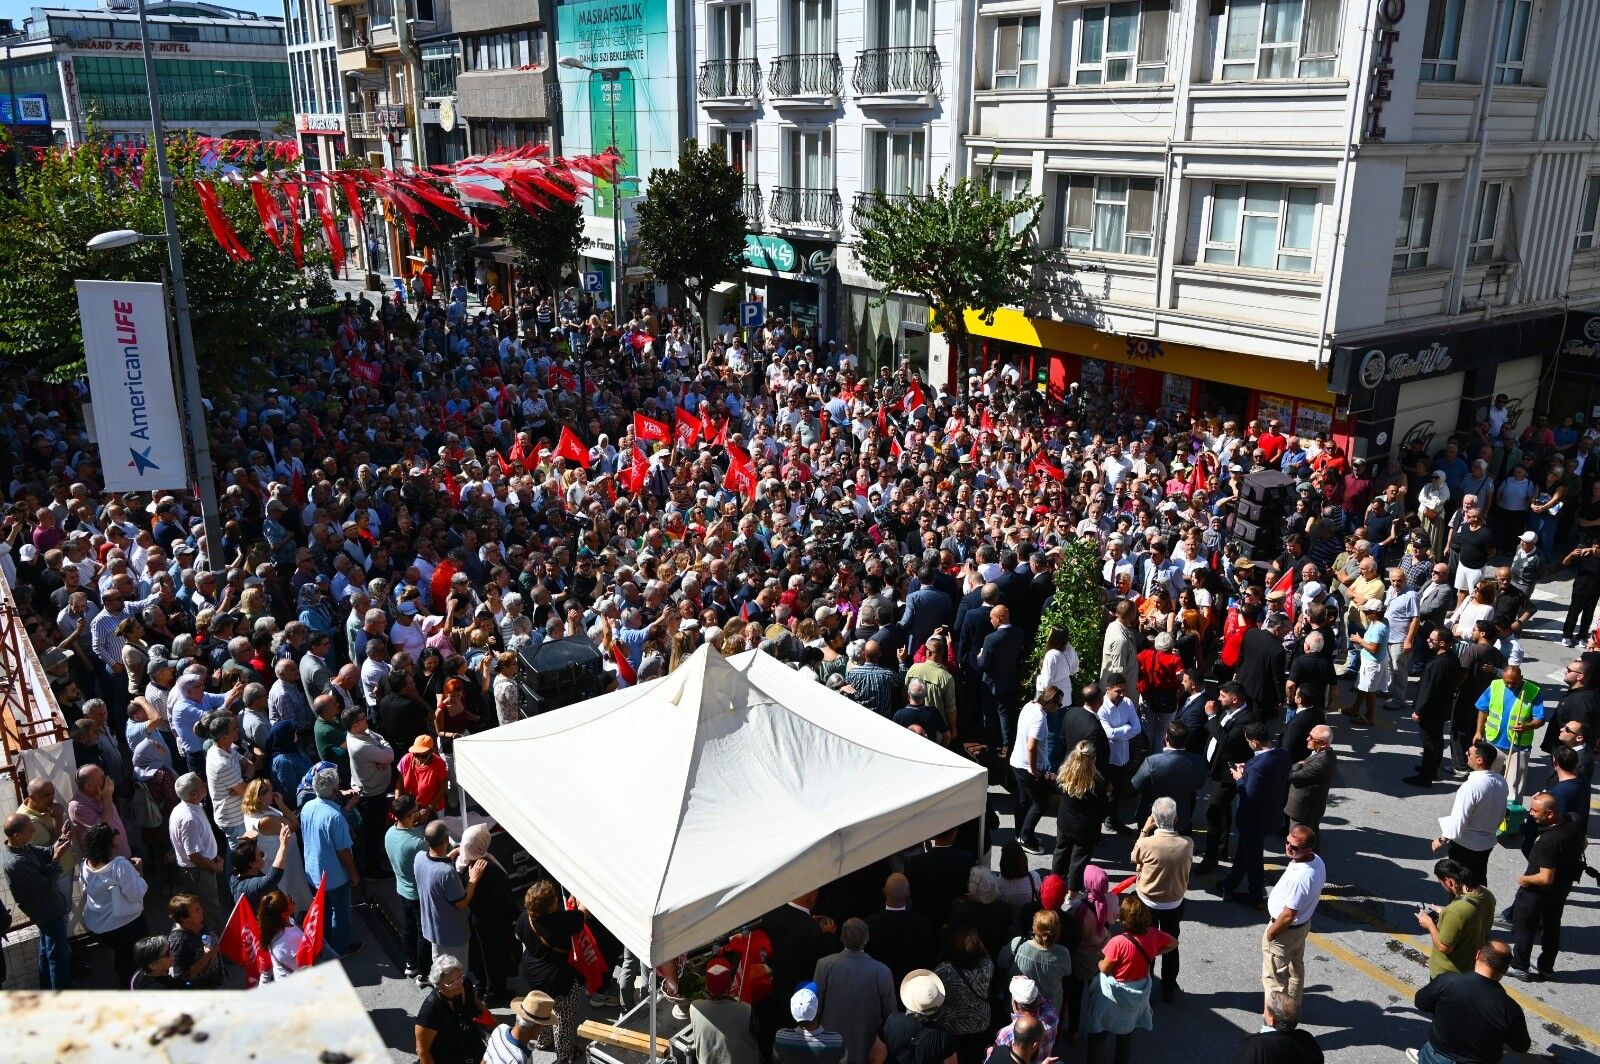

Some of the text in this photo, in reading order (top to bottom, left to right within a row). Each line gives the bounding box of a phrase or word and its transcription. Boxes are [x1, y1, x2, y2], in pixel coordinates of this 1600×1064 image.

[579, 4, 643, 26] MASRAFSIZLIK
[160, 42, 190, 52] HOTEL
[609, 50, 644, 61] BEKLEMEKTE
[597, 238, 615, 251] Finan
[586, 274, 598, 290] P
[745, 305, 758, 324] P
[113, 299, 149, 440] AmericanLIFE
